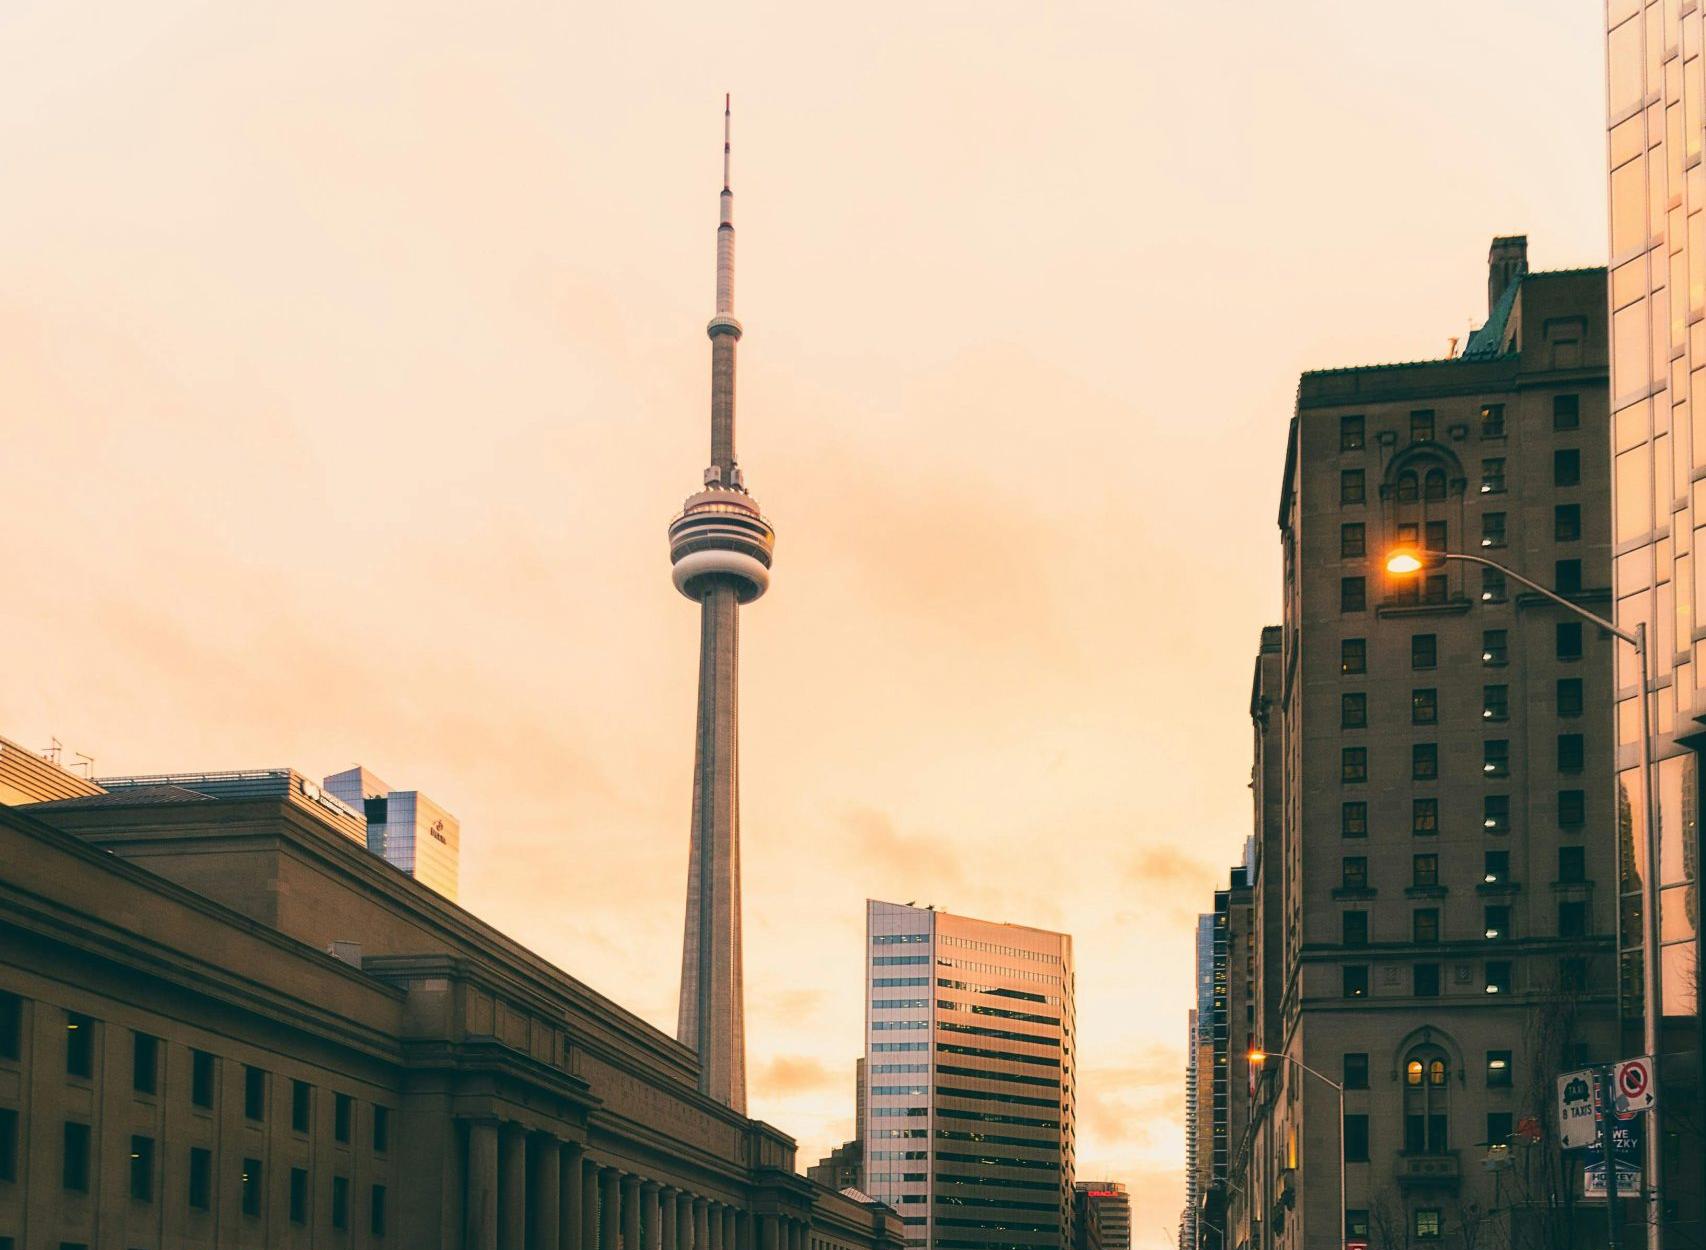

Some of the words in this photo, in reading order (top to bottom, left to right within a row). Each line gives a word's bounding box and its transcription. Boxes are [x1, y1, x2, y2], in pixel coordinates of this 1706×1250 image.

[1571, 1104, 1592, 1118] TAXIS
[1598, 1129, 1629, 1139] HWE
[1592, 1173, 1633, 1181] HOKEY
